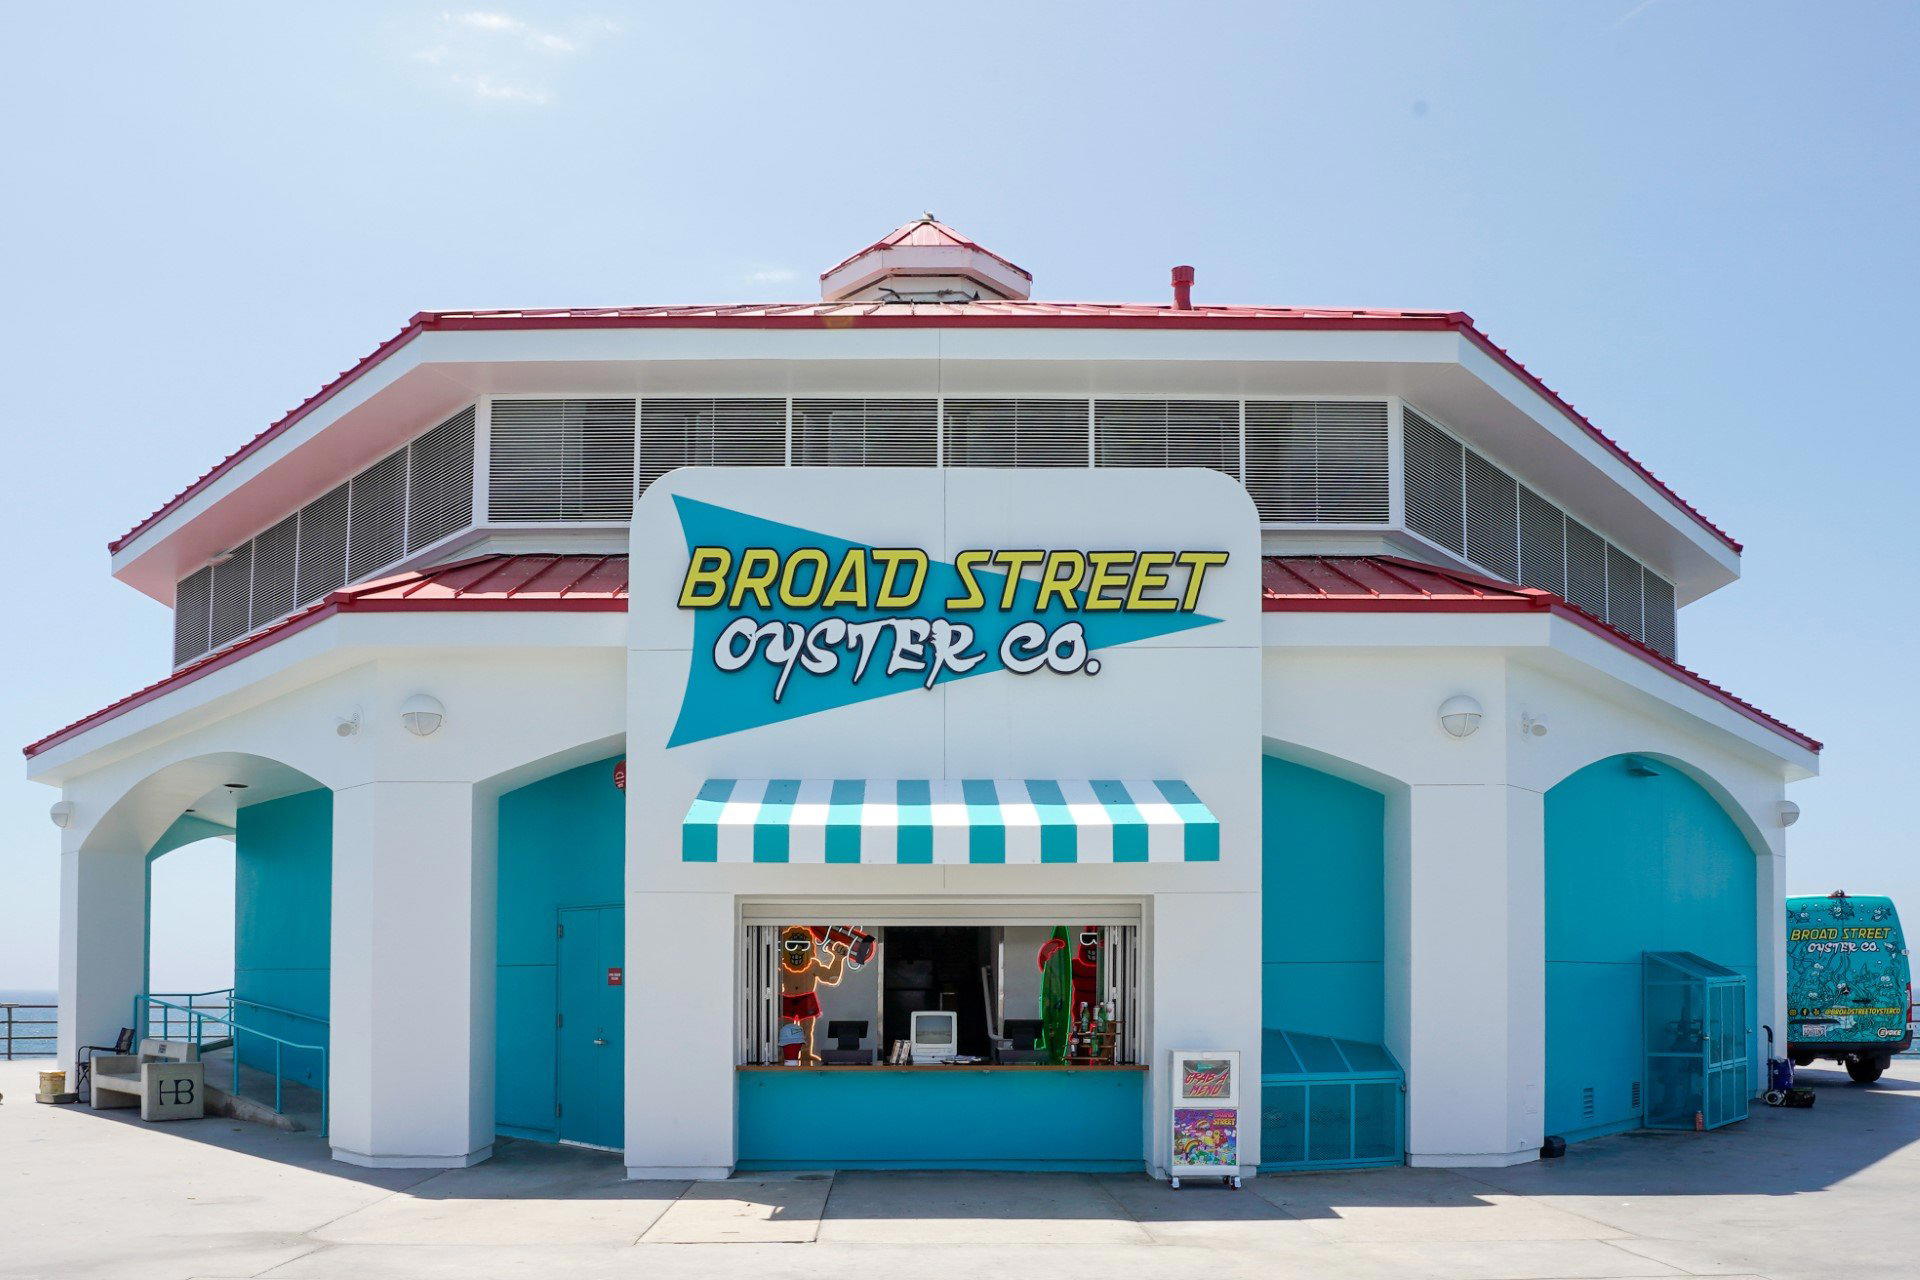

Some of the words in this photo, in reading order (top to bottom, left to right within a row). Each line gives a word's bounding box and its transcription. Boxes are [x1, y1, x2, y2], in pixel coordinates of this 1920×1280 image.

[677, 546, 928, 610] BROAD
[944, 549, 1230, 613] STREET
[712, 616, 987, 703] OYSTER
[998, 619, 1102, 676] CO.
[1790, 928, 1838, 941] BROAD
[1842, 927, 1891, 939] STREET
[1807, 942, 1859, 955] OYSTER
[1861, 942, 1879, 952] CO.
[1185, 1072, 1215, 1085] GRAB
[1216, 1072, 1229, 1084] A
[159, 1078, 194, 1106] HB
[1189, 1084, 1223, 1097] MENU
